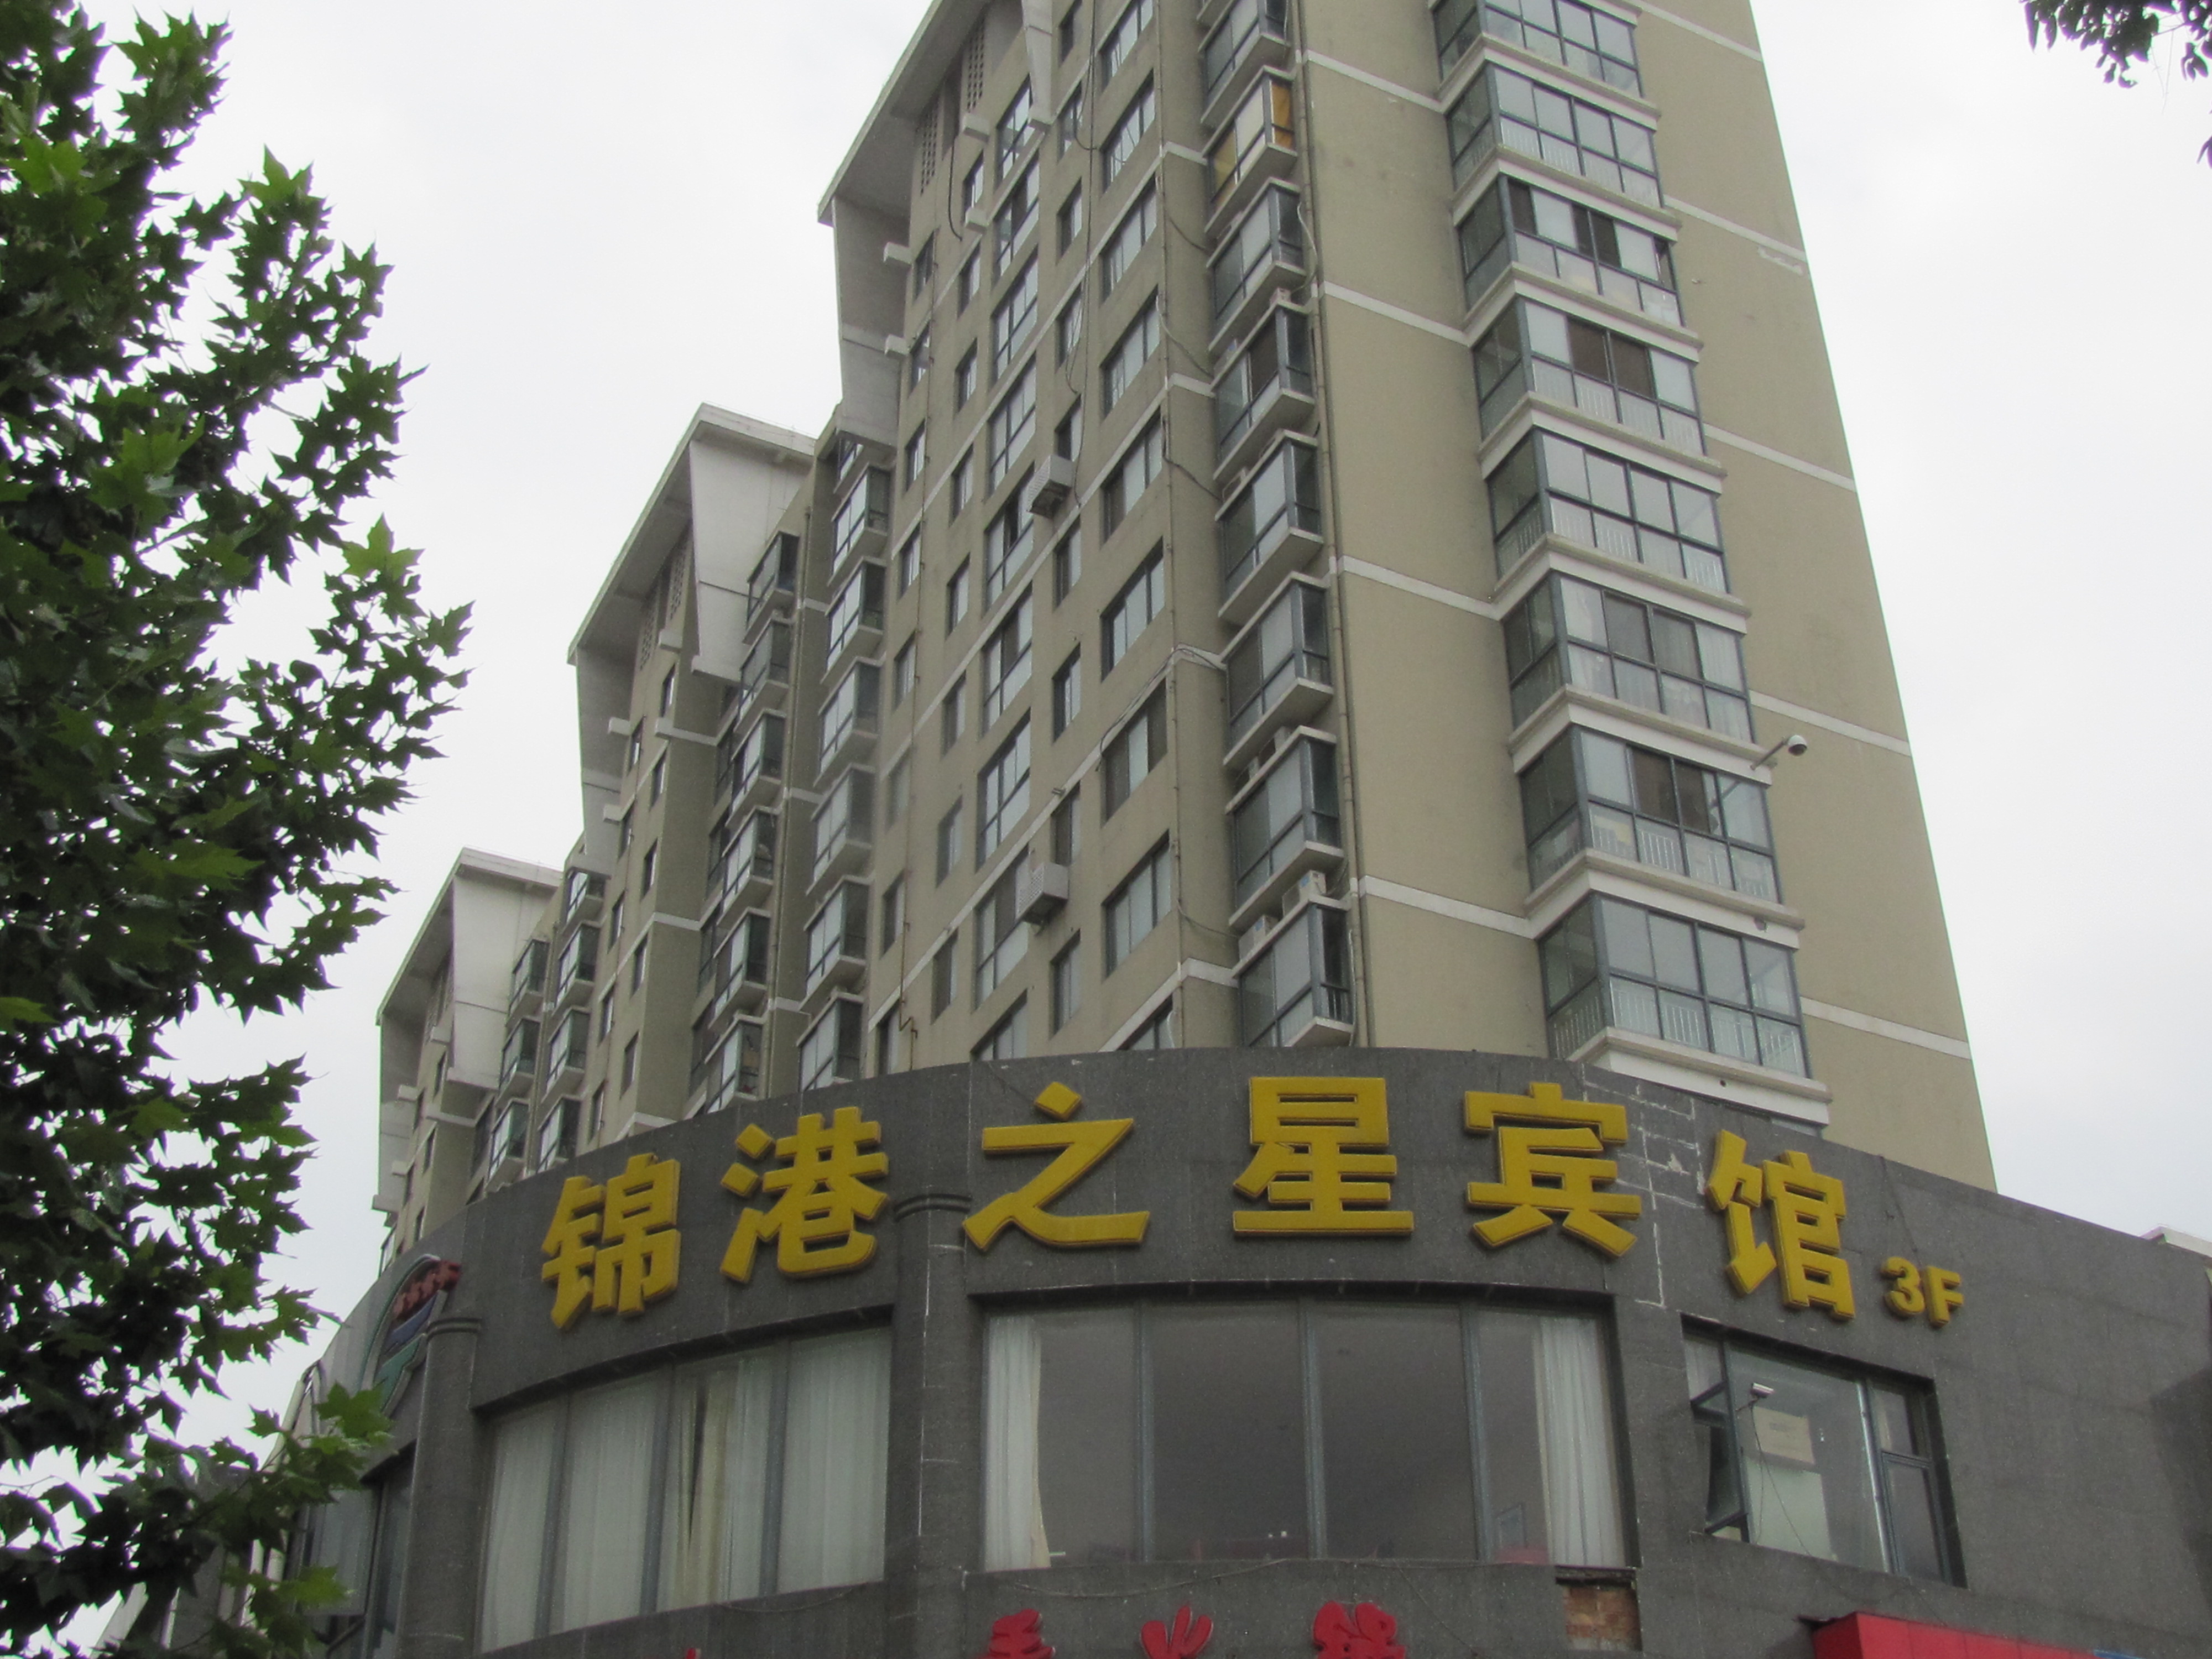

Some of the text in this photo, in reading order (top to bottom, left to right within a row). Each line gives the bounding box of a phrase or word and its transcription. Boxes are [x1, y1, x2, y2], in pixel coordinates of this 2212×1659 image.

[541, 1076, 1964, 1330] 锦港之星宾馆 3F
